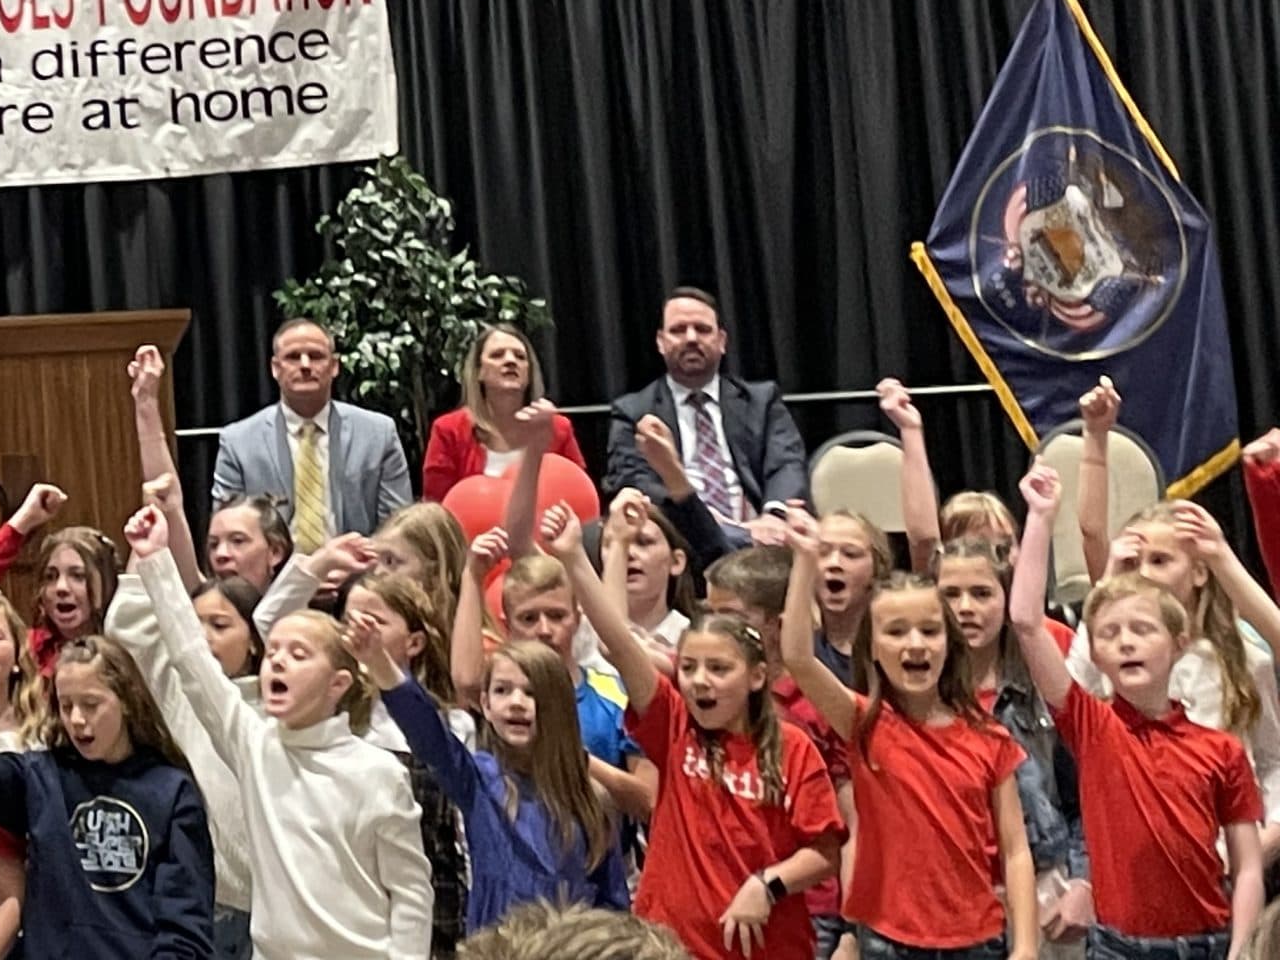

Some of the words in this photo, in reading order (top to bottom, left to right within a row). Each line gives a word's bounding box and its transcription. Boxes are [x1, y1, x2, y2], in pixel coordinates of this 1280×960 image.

[31, 28, 331, 81] difference
[81, 95, 141, 131] at
[170, 82, 329, 126] home
